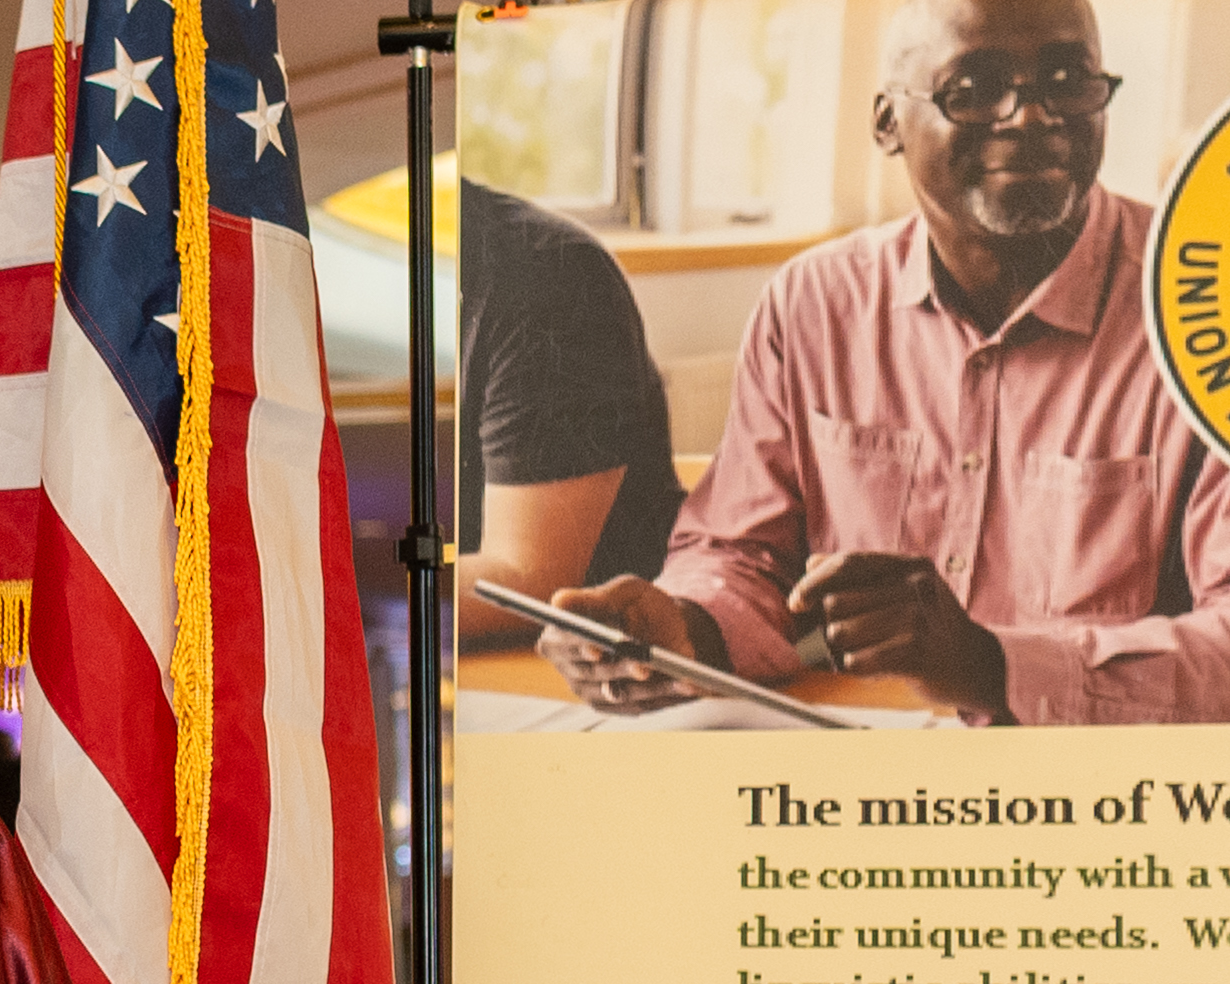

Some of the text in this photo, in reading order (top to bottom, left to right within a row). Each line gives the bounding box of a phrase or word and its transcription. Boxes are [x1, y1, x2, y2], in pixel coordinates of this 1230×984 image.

[1176, 241, 1230, 394] UNION
[738, 780, 1230, 826] The mission of W
[738, 856, 810, 890] the
[818, 857, 1066, 898] community
[1077, 854, 1173, 889] with
[1187, 865, 1211, 889] a
[738, 915, 1230, 958] their unique needs. W
